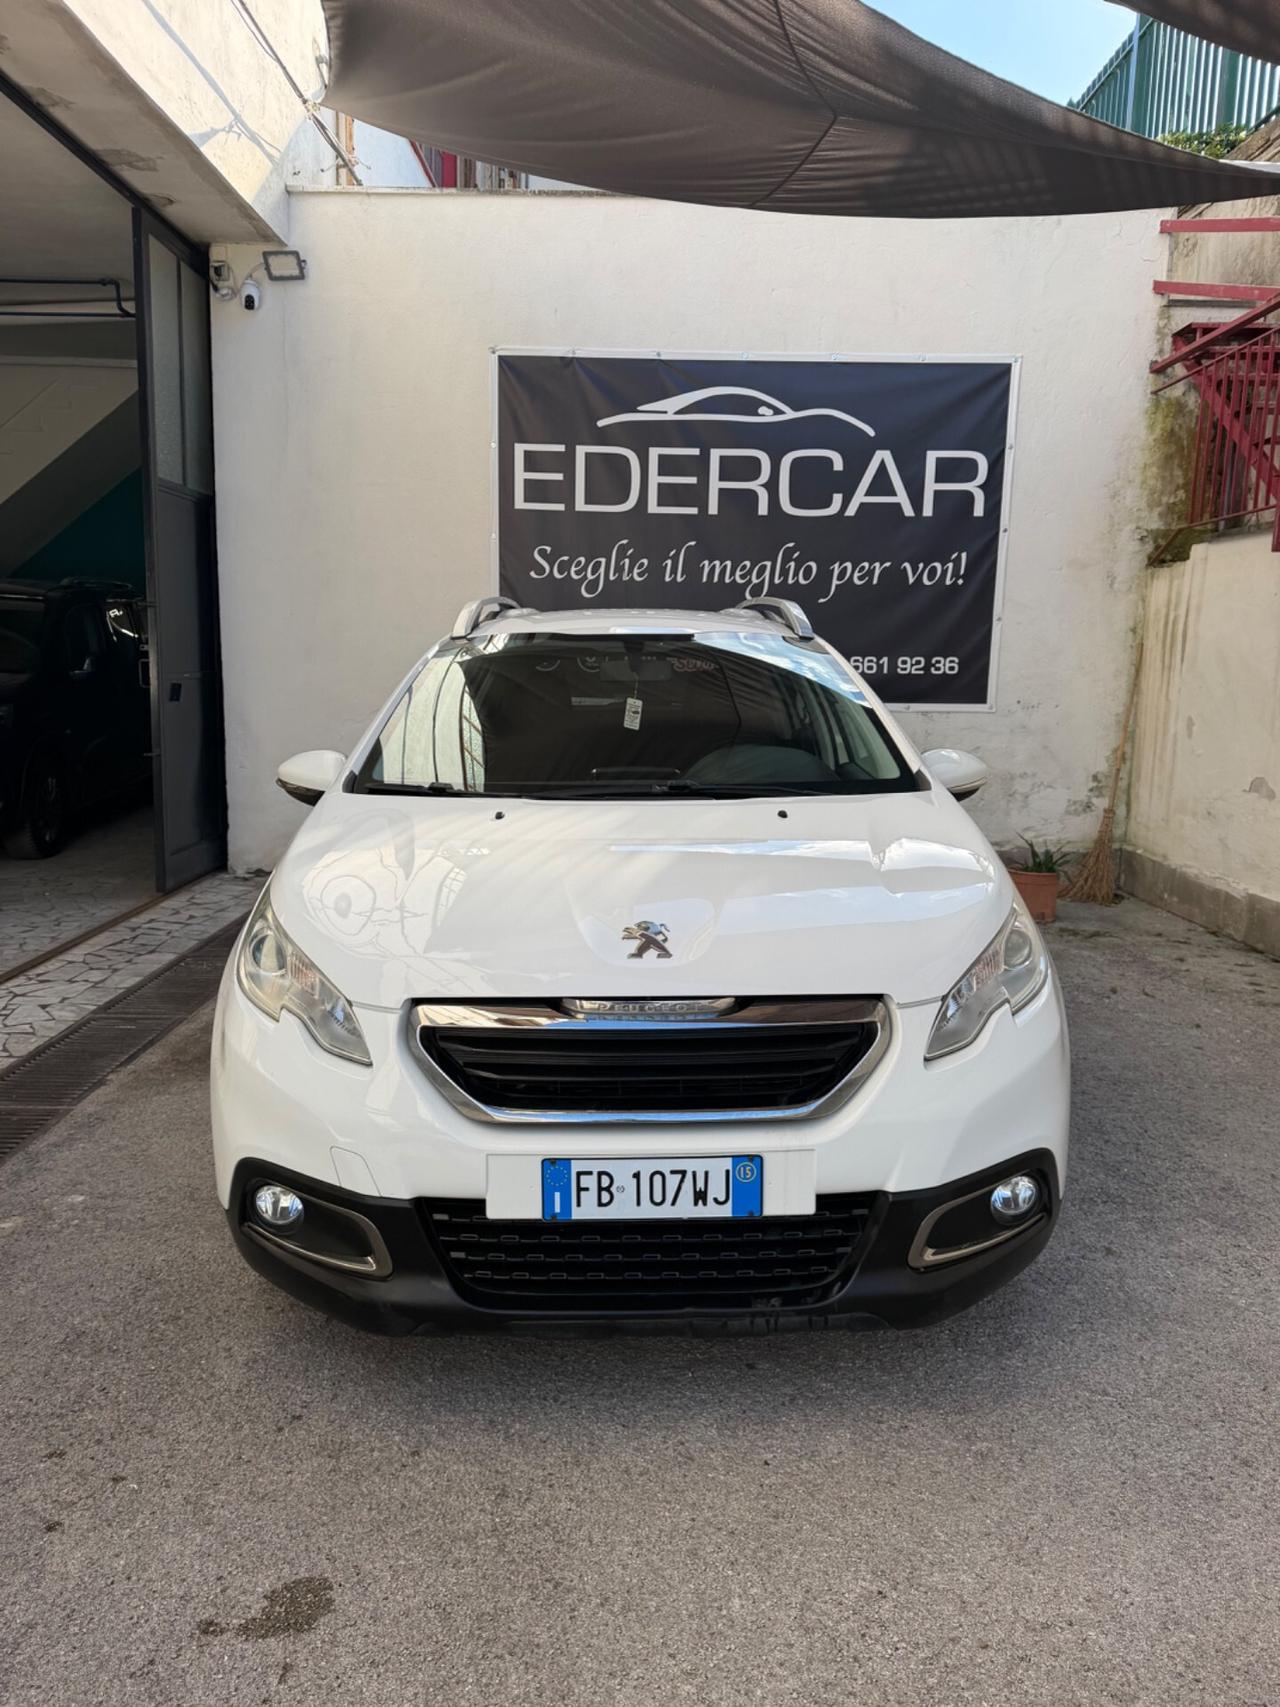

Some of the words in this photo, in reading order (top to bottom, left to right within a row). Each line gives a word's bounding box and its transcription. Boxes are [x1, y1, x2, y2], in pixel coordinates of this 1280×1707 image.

[513, 442, 989, 518] EDERCAR
[529, 539, 649, 599] Sceglie
[662, 541, 698, 584] il
[699, 542, 818, 601] meglio
[818, 558, 892, 604] per
[900, 551, 967, 586] voi!
[850, 656, 889, 674] 661
[897, 656, 925, 674] 92
[930, 656, 959, 674] 36
[575, 1170, 615, 1208] FB
[632, 1169, 731, 1208] 107WJ
